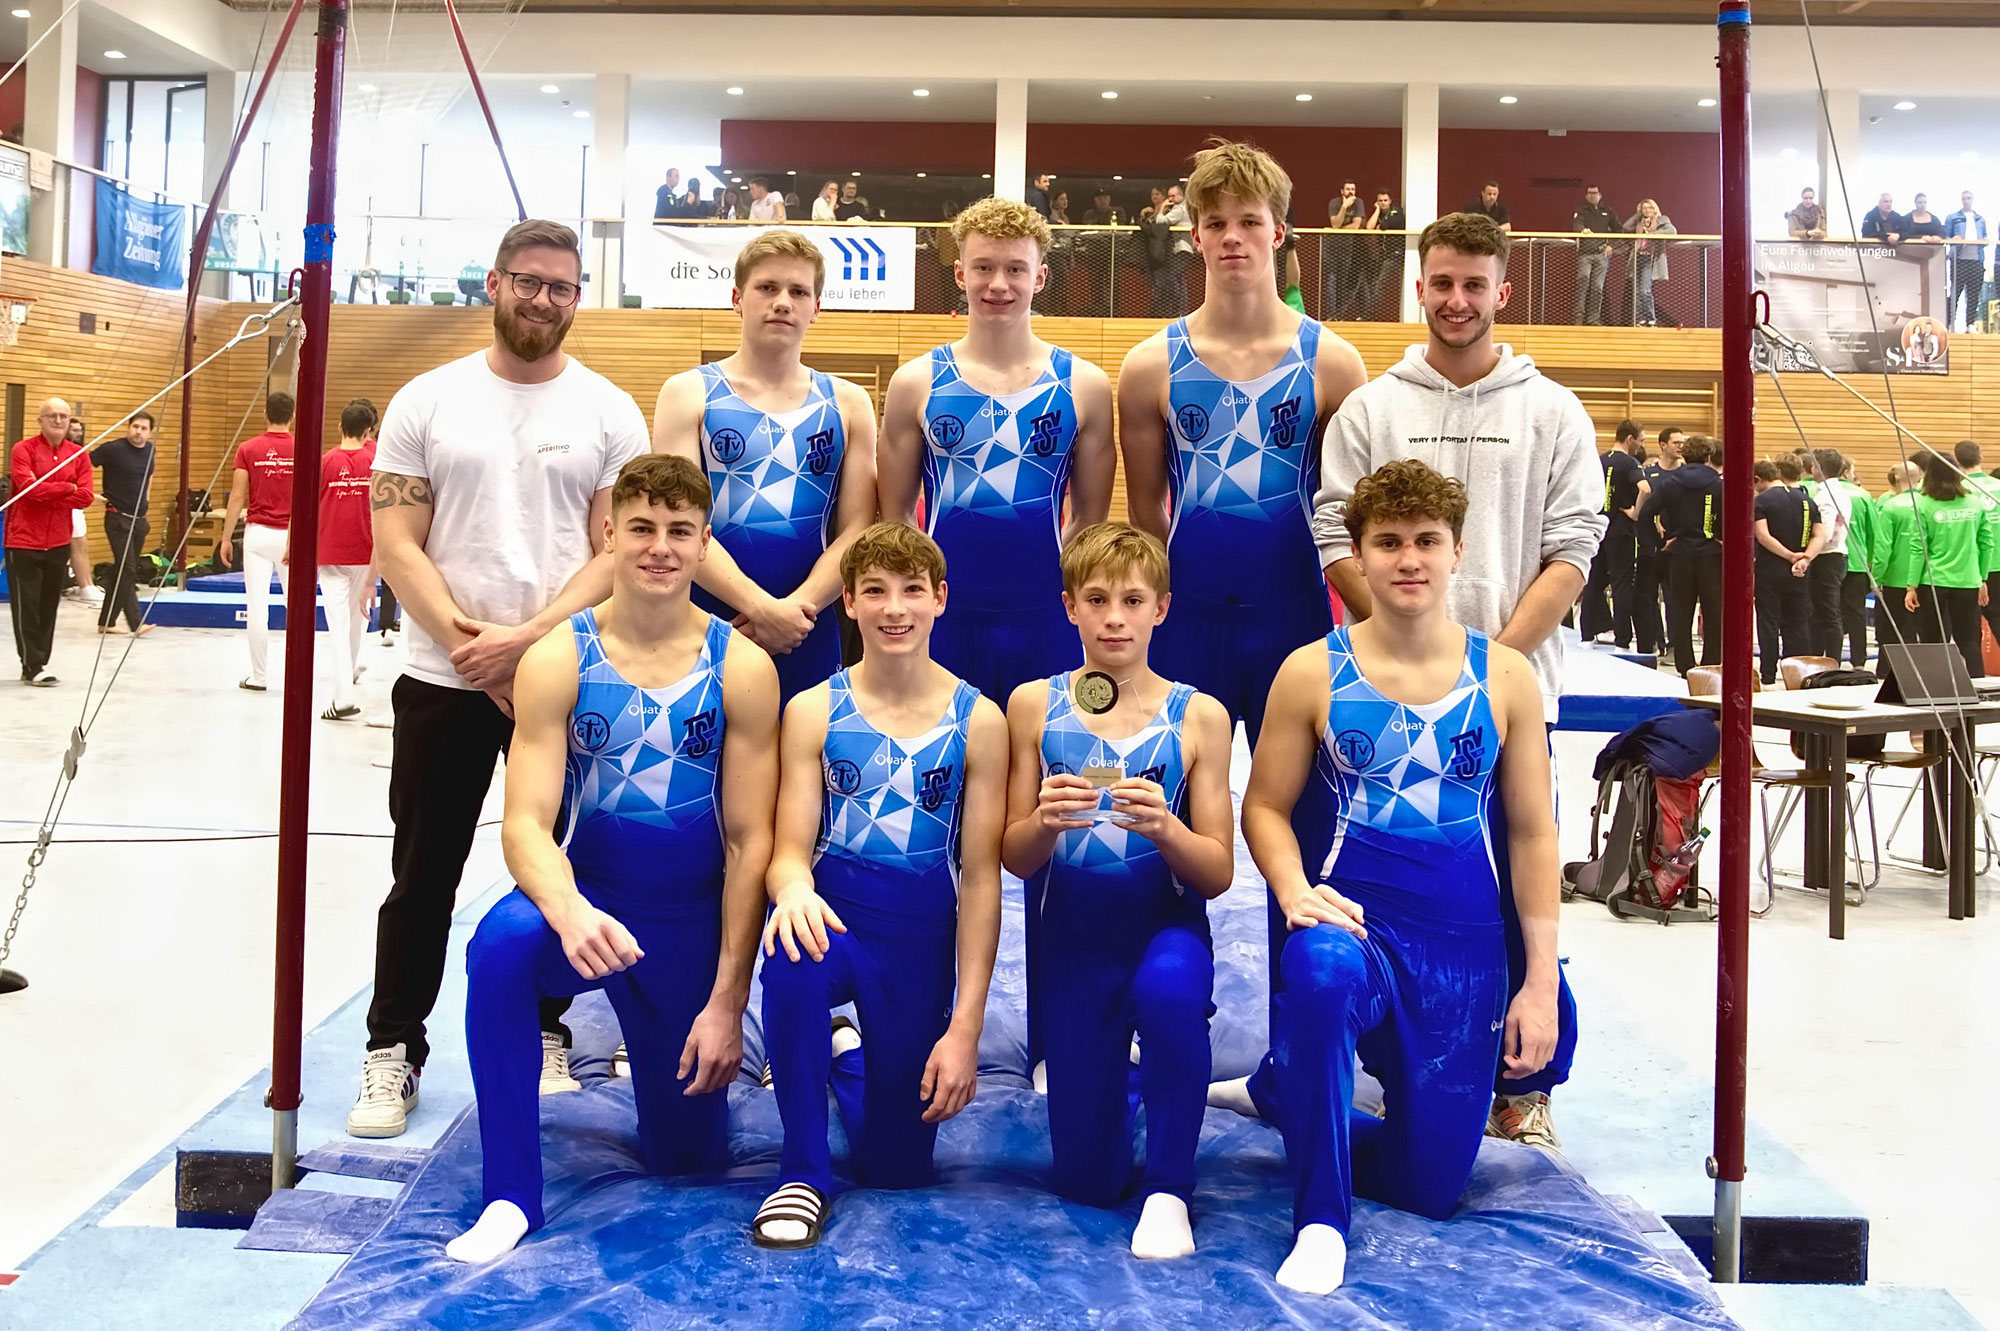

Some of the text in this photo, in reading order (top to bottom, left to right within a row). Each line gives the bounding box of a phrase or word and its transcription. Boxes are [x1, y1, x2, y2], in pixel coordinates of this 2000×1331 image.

[123, 236, 161, 271] Zeitung
[1760, 244, 1787, 256] Eure
[670, 261, 735, 280] die So
[849, 287, 886, 300] leben
[1408, 436, 1429, 444] VERY
[1476, 436, 1510, 444] PERSON
[537, 443, 570, 454] APERITIVO
[875, 753, 917, 767] Quato
[1088, 756, 1130, 769] Quato
[370, 1051, 392, 1060] adidas
